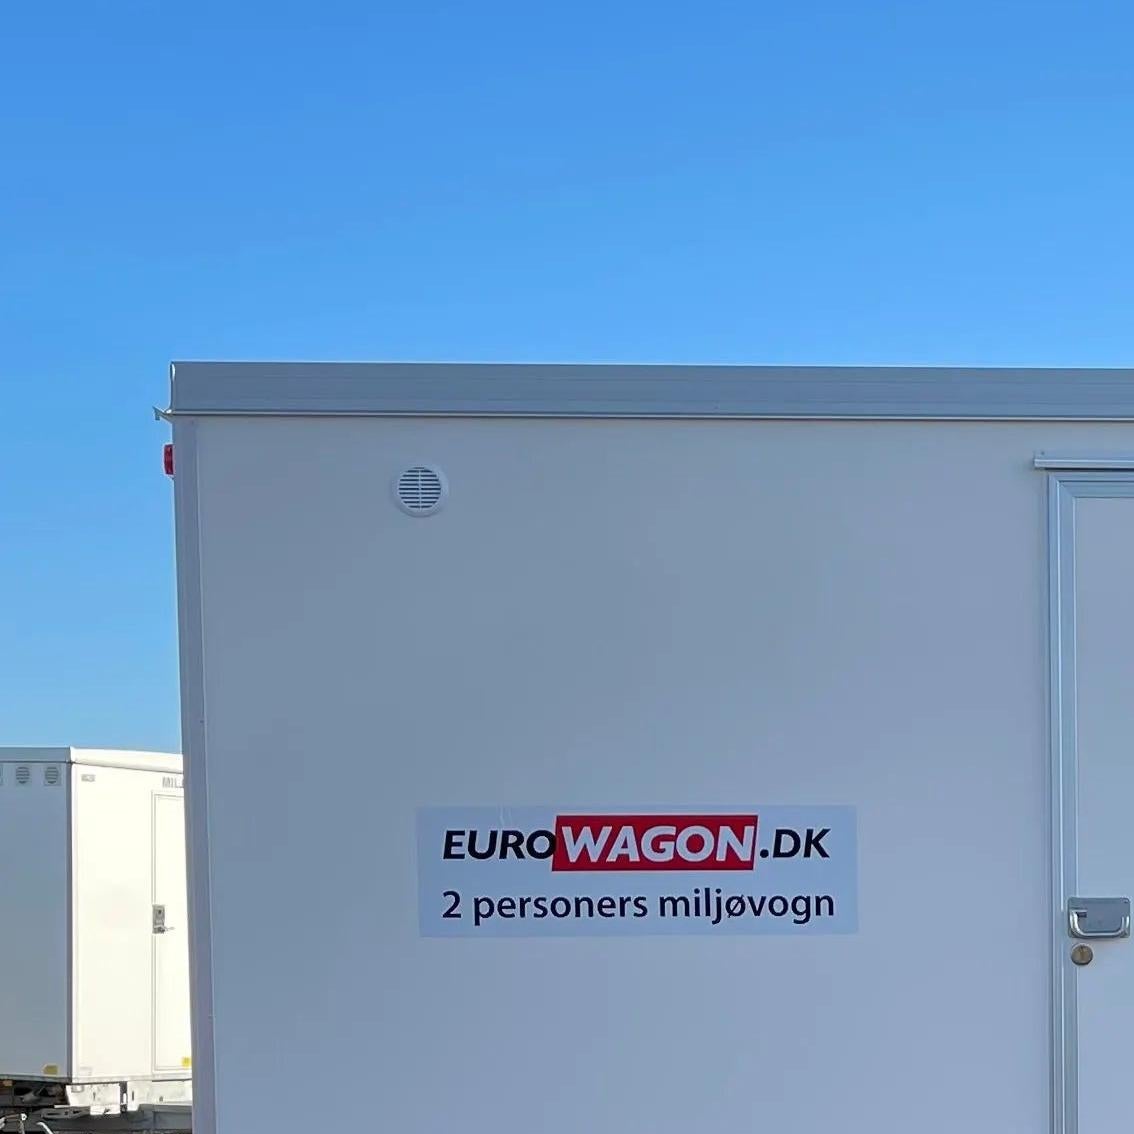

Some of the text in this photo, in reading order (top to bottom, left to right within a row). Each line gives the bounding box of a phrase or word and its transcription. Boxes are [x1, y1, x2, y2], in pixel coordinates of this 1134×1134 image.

[443, 825, 831, 863] EUROWAGON.DK
[442, 887, 834, 926] 2 personers miljøvogn
